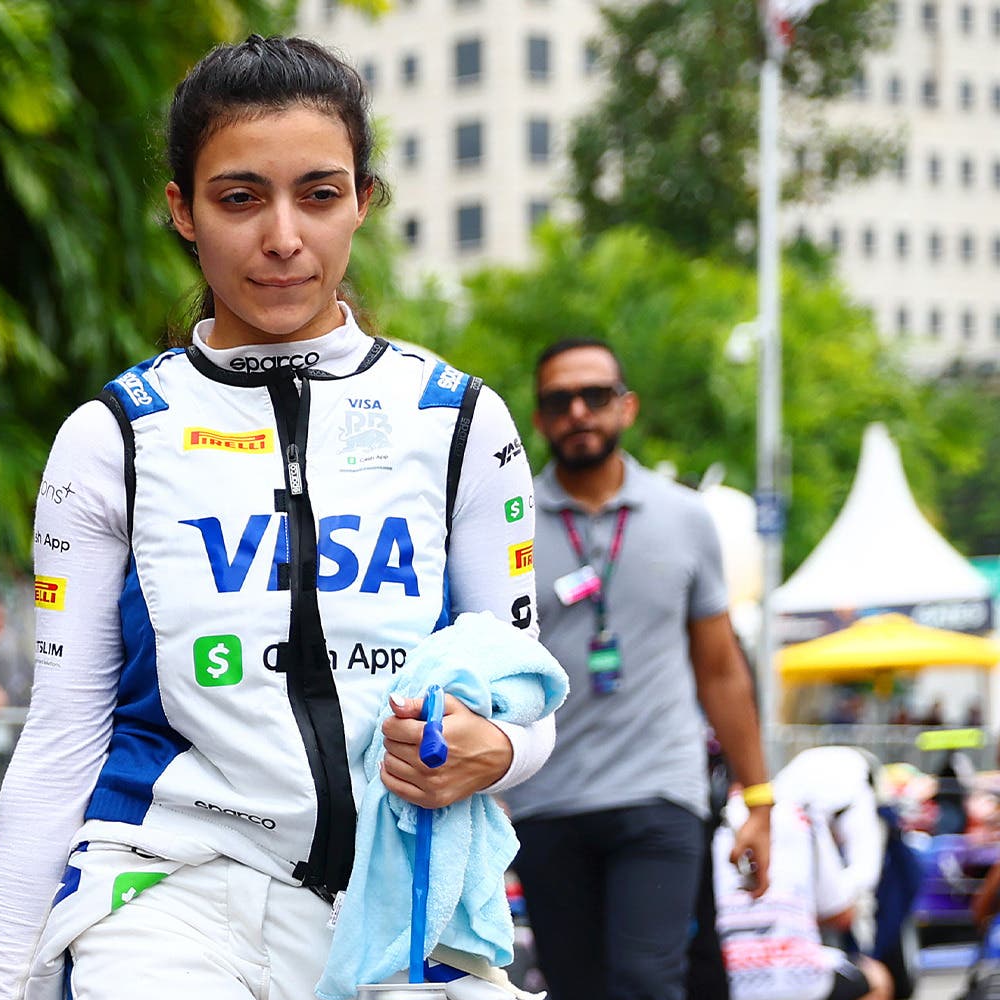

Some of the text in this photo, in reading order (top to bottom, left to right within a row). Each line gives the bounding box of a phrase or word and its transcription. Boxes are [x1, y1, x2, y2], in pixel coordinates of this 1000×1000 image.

[229, 352, 320, 374] sparco
[348, 399, 382, 410] VISA
[190, 431, 266, 450] PIRELLI
[43, 533, 71, 553] App
[347, 643, 407, 675] App
